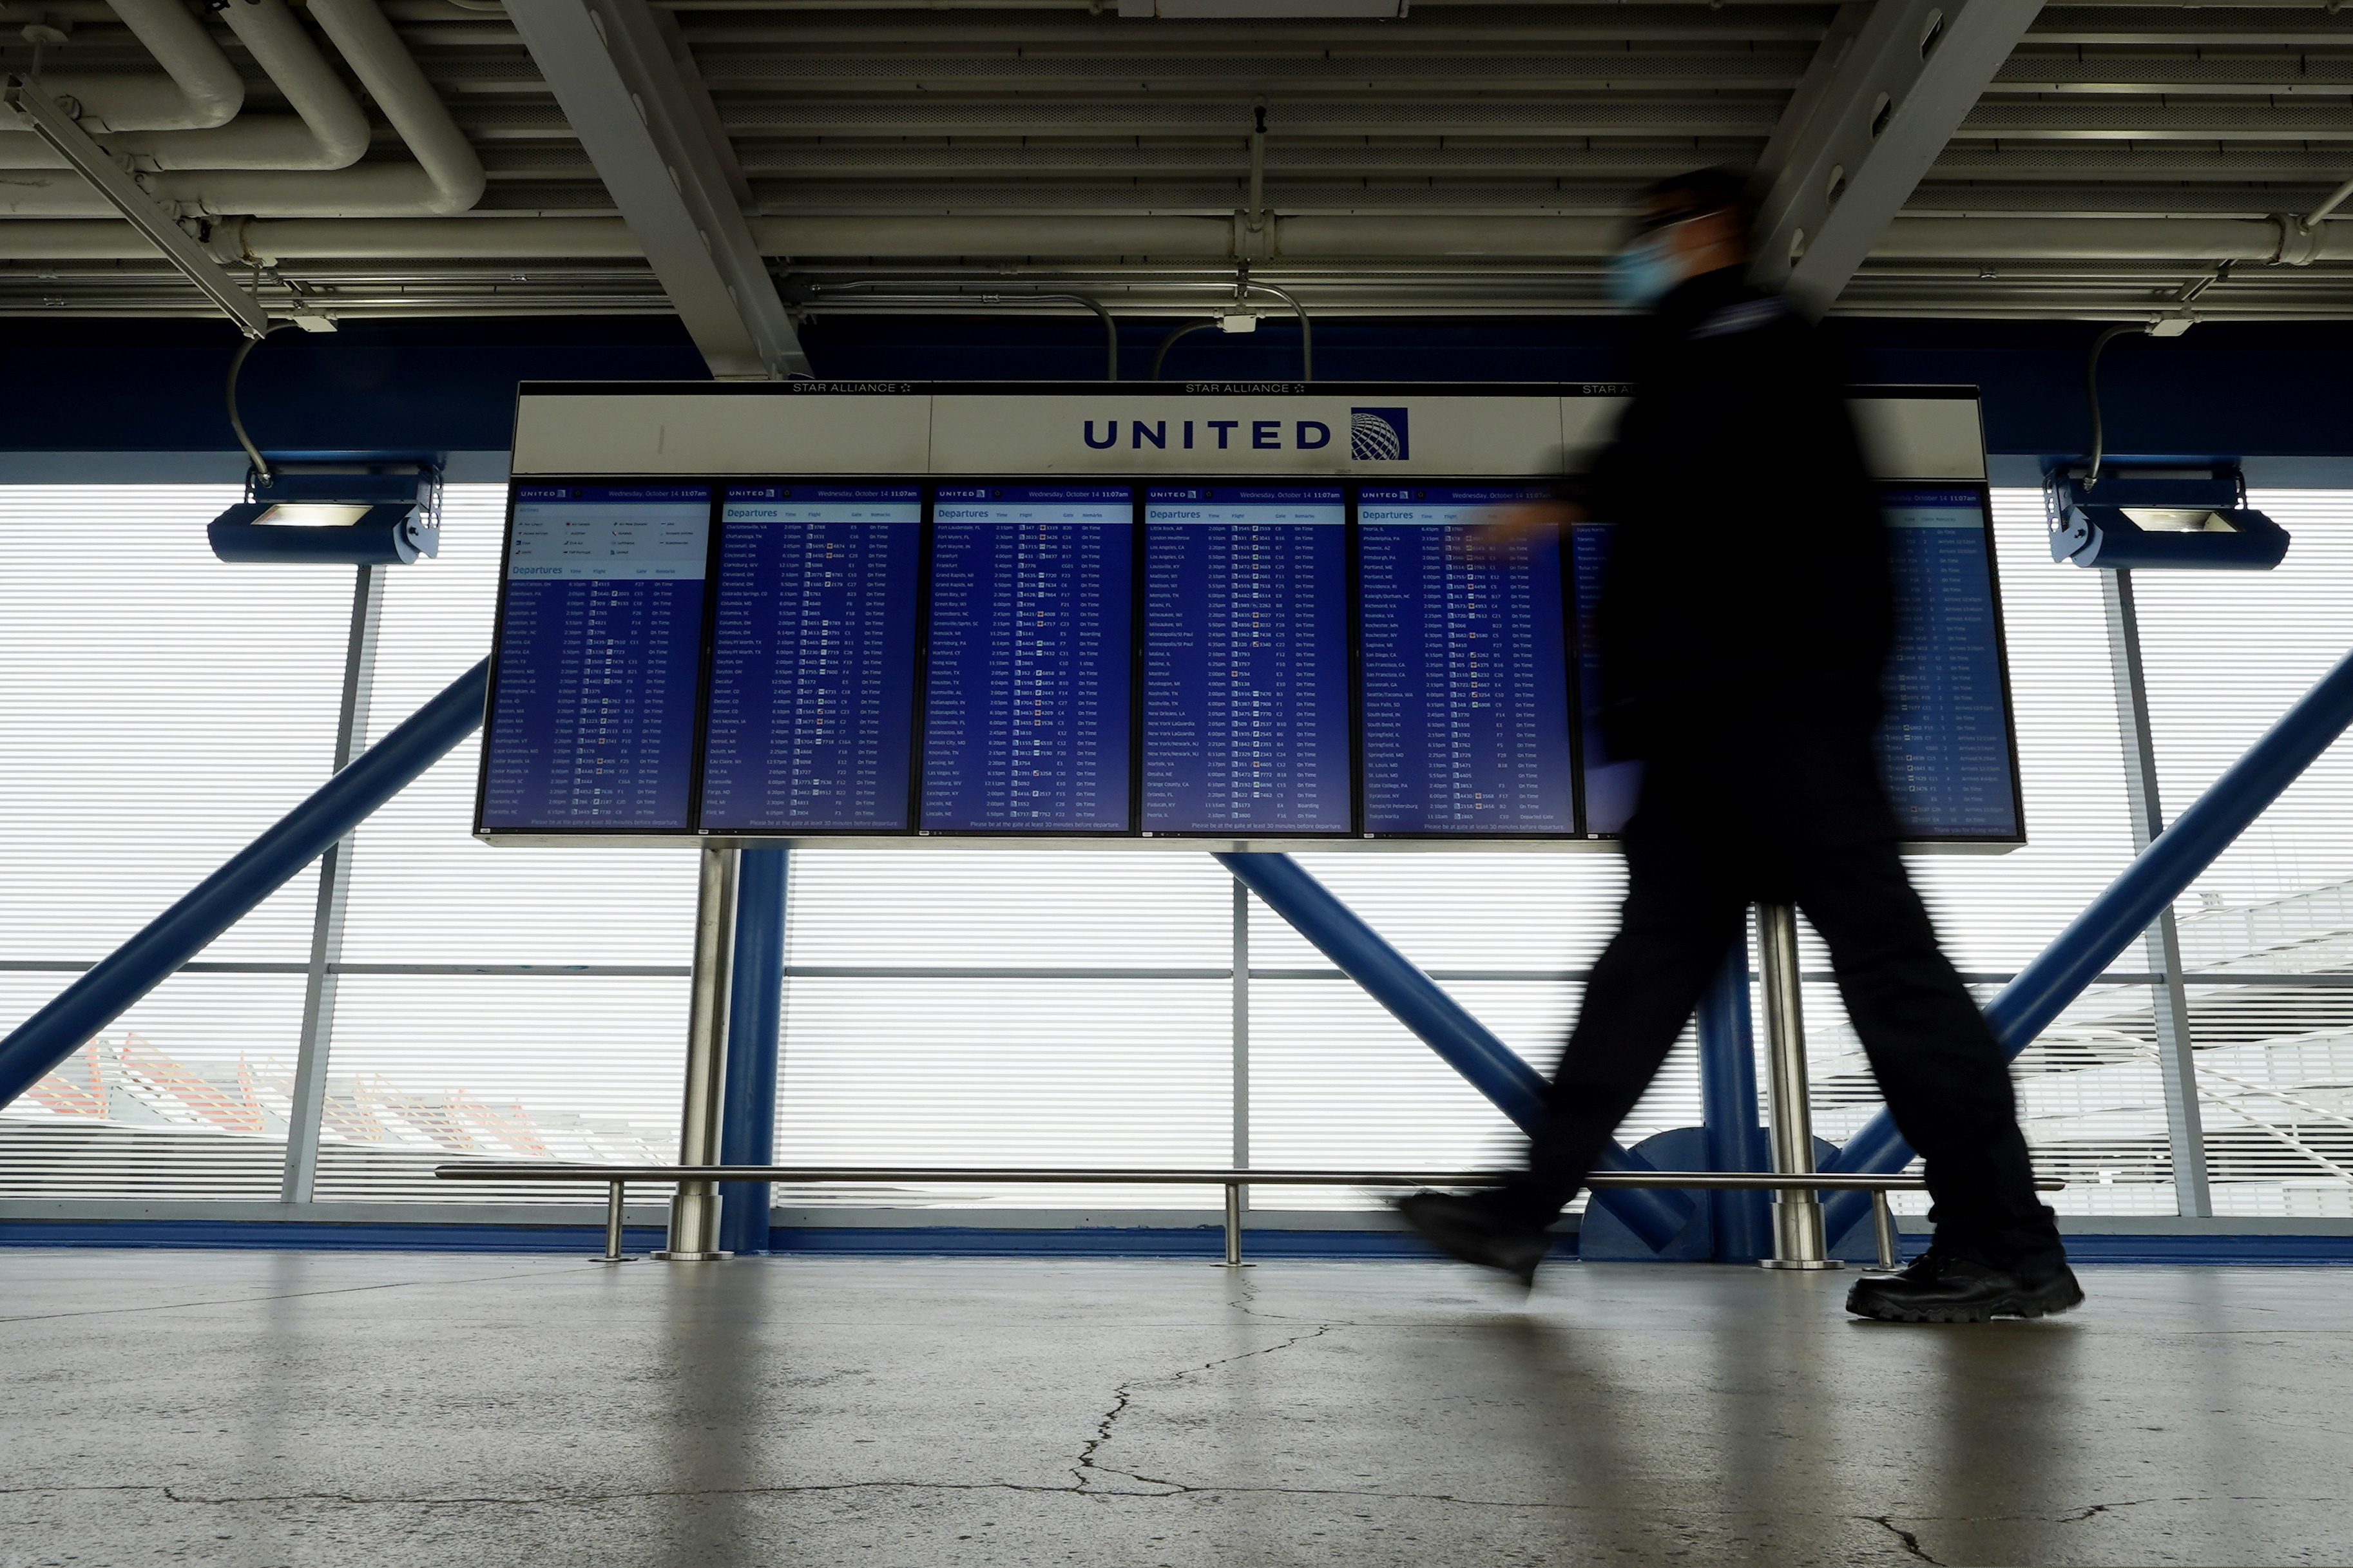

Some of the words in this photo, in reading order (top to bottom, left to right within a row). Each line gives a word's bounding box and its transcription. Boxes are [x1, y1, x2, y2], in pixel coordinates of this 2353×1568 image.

[793, 383, 826, 392] STAR
[831, 384, 895, 392] ALLIANCE
[1186, 384, 1219, 392] STAR
[1224, 384, 1289, 392] ALLIANCE
[1583, 385, 1616, 393] STAR
[1084, 421, 1330, 449] UNITED
